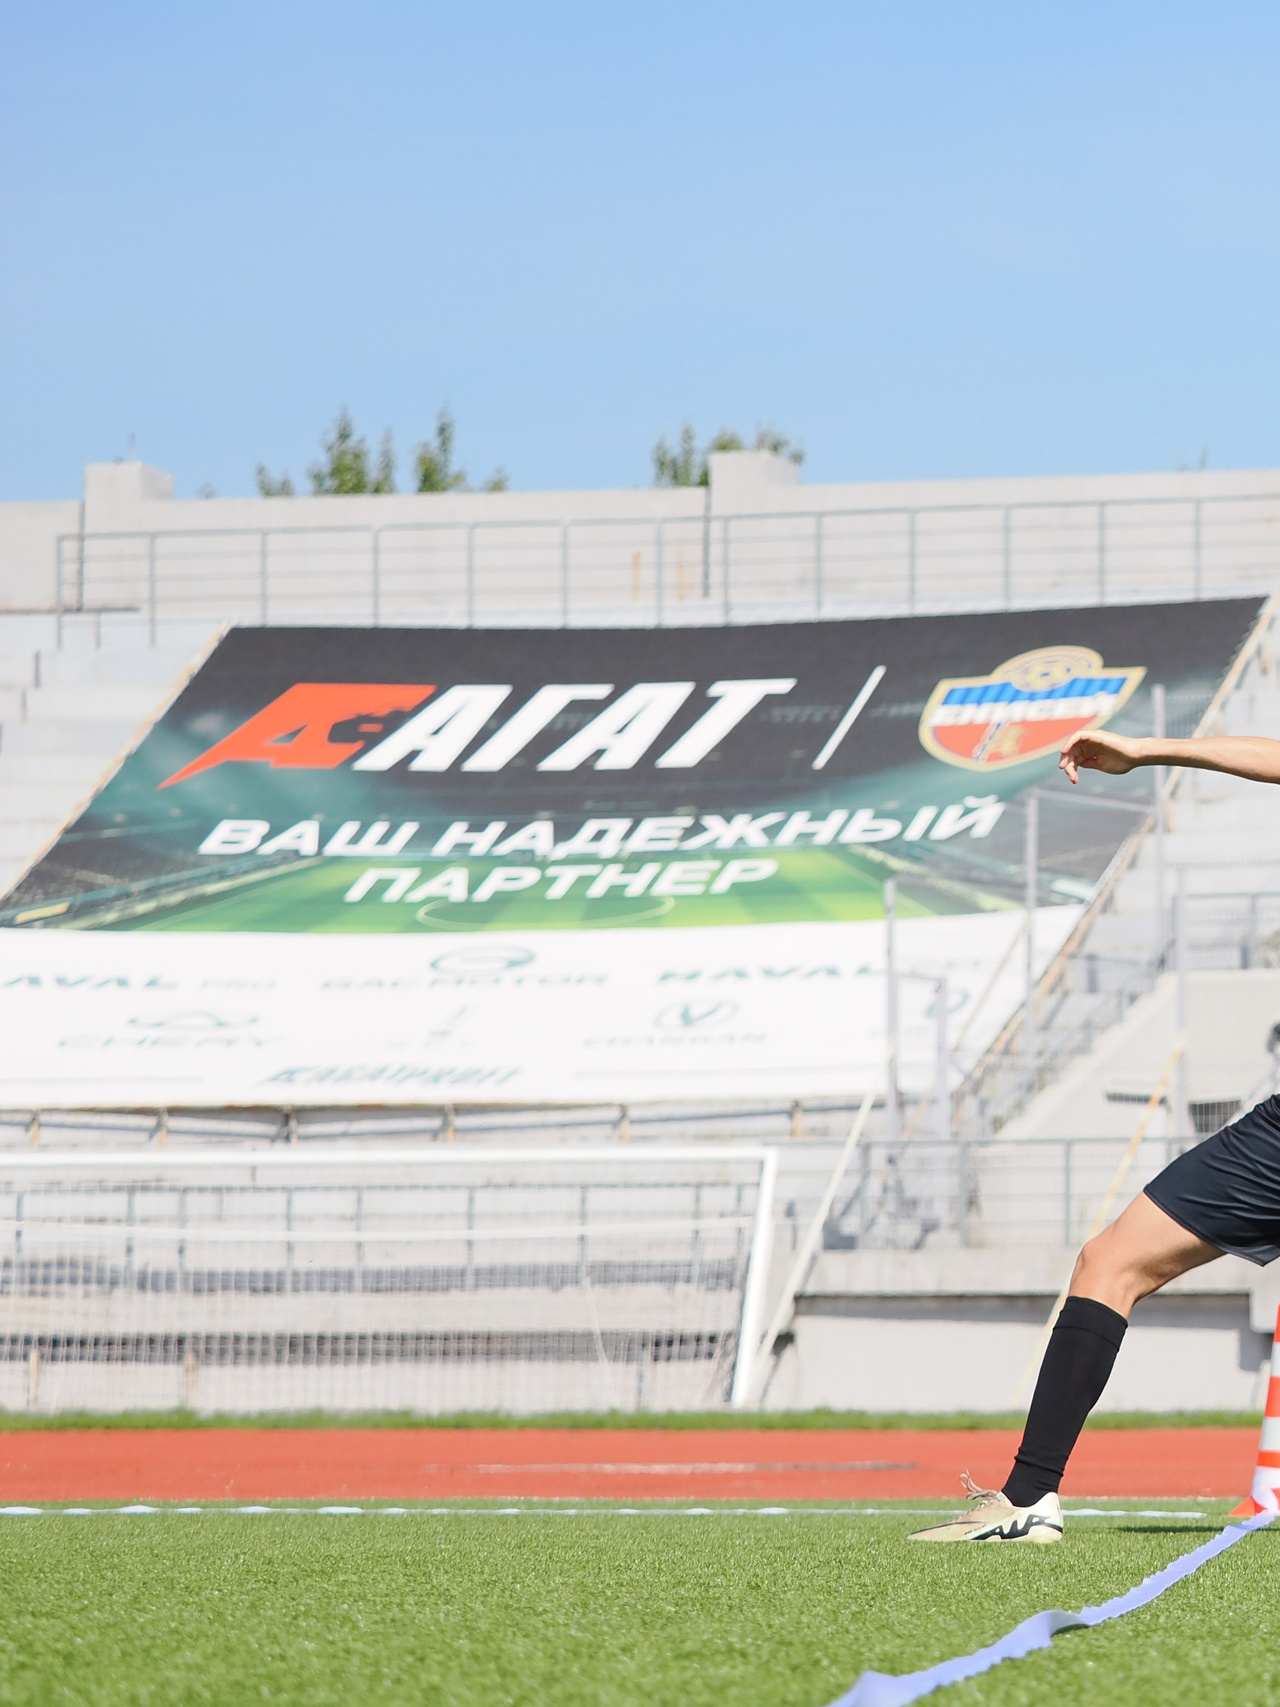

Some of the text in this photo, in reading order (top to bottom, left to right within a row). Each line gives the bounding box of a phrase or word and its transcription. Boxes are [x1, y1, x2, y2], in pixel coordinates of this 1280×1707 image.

[352, 678, 797, 772] АГАТ
[198, 795, 1006, 861] ВАШ НАДЕЖНЫЙ
[345, 858, 779, 903] ПАРТНЕР
[0, 975, 179, 991] AVAL
[656, 963, 888, 985] HAVAL
